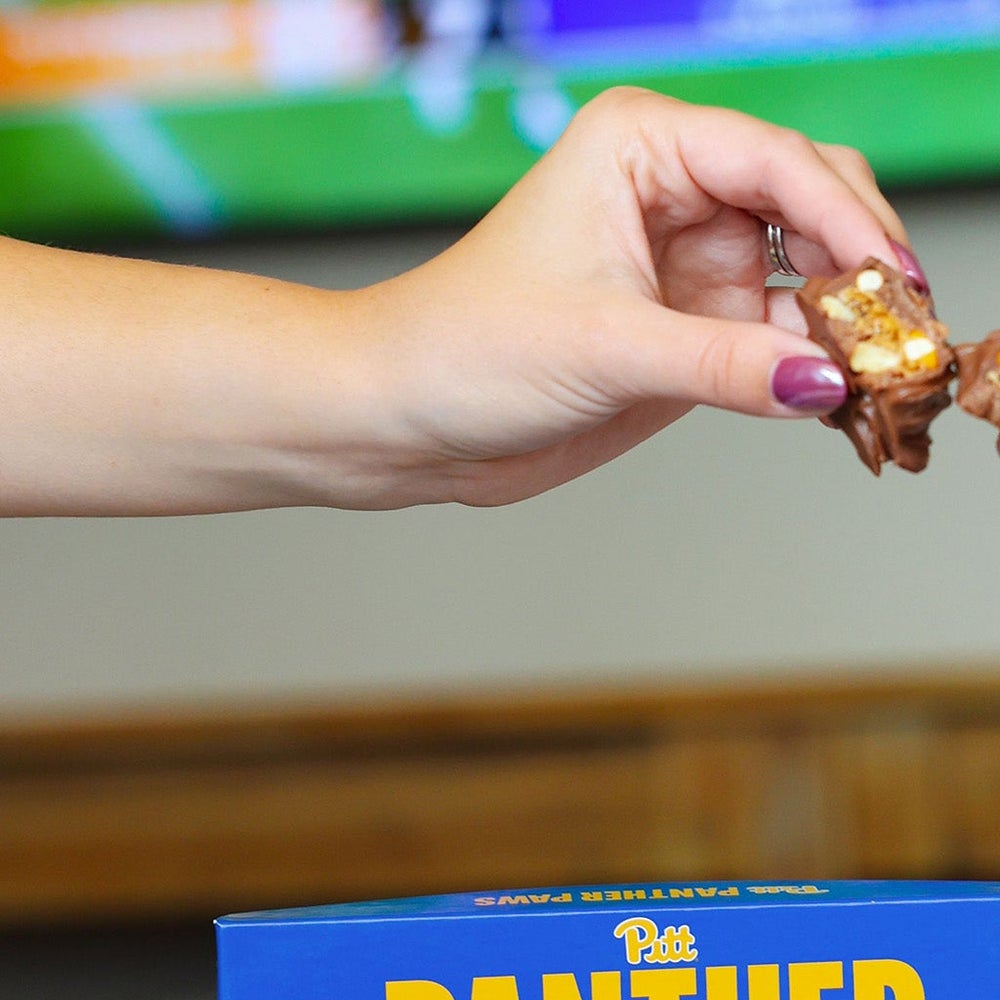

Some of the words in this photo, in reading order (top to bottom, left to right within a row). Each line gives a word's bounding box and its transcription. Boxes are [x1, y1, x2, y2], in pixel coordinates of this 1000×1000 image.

[474, 892, 573, 907] PAWS
[581, 886, 739, 902] PANTHER
[613, 917, 698, 965] Pitt
